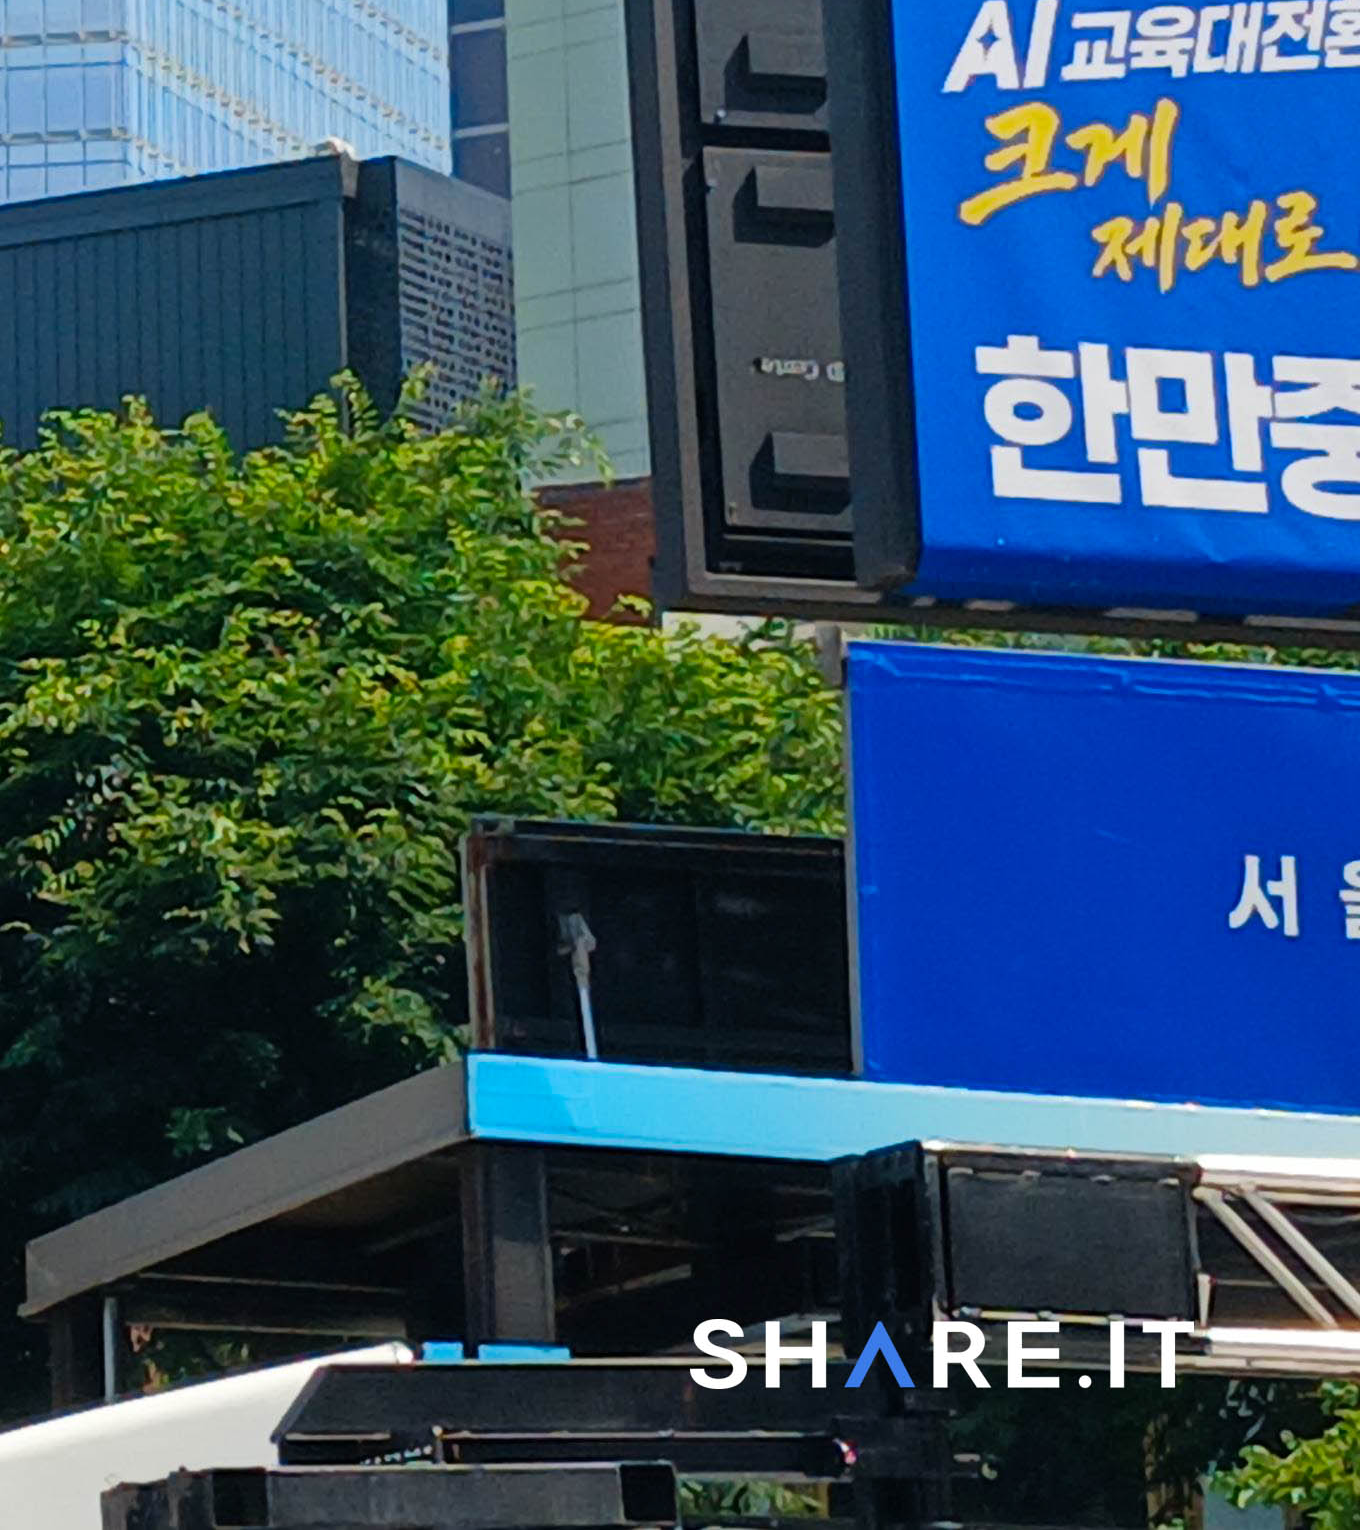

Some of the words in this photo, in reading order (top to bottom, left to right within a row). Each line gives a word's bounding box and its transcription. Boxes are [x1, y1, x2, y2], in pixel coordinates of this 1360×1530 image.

[959, 97, 1179, 226] 크게
[1091, 191, 1359, 294] 제대로
[751, 357, 820, 381] Cente
